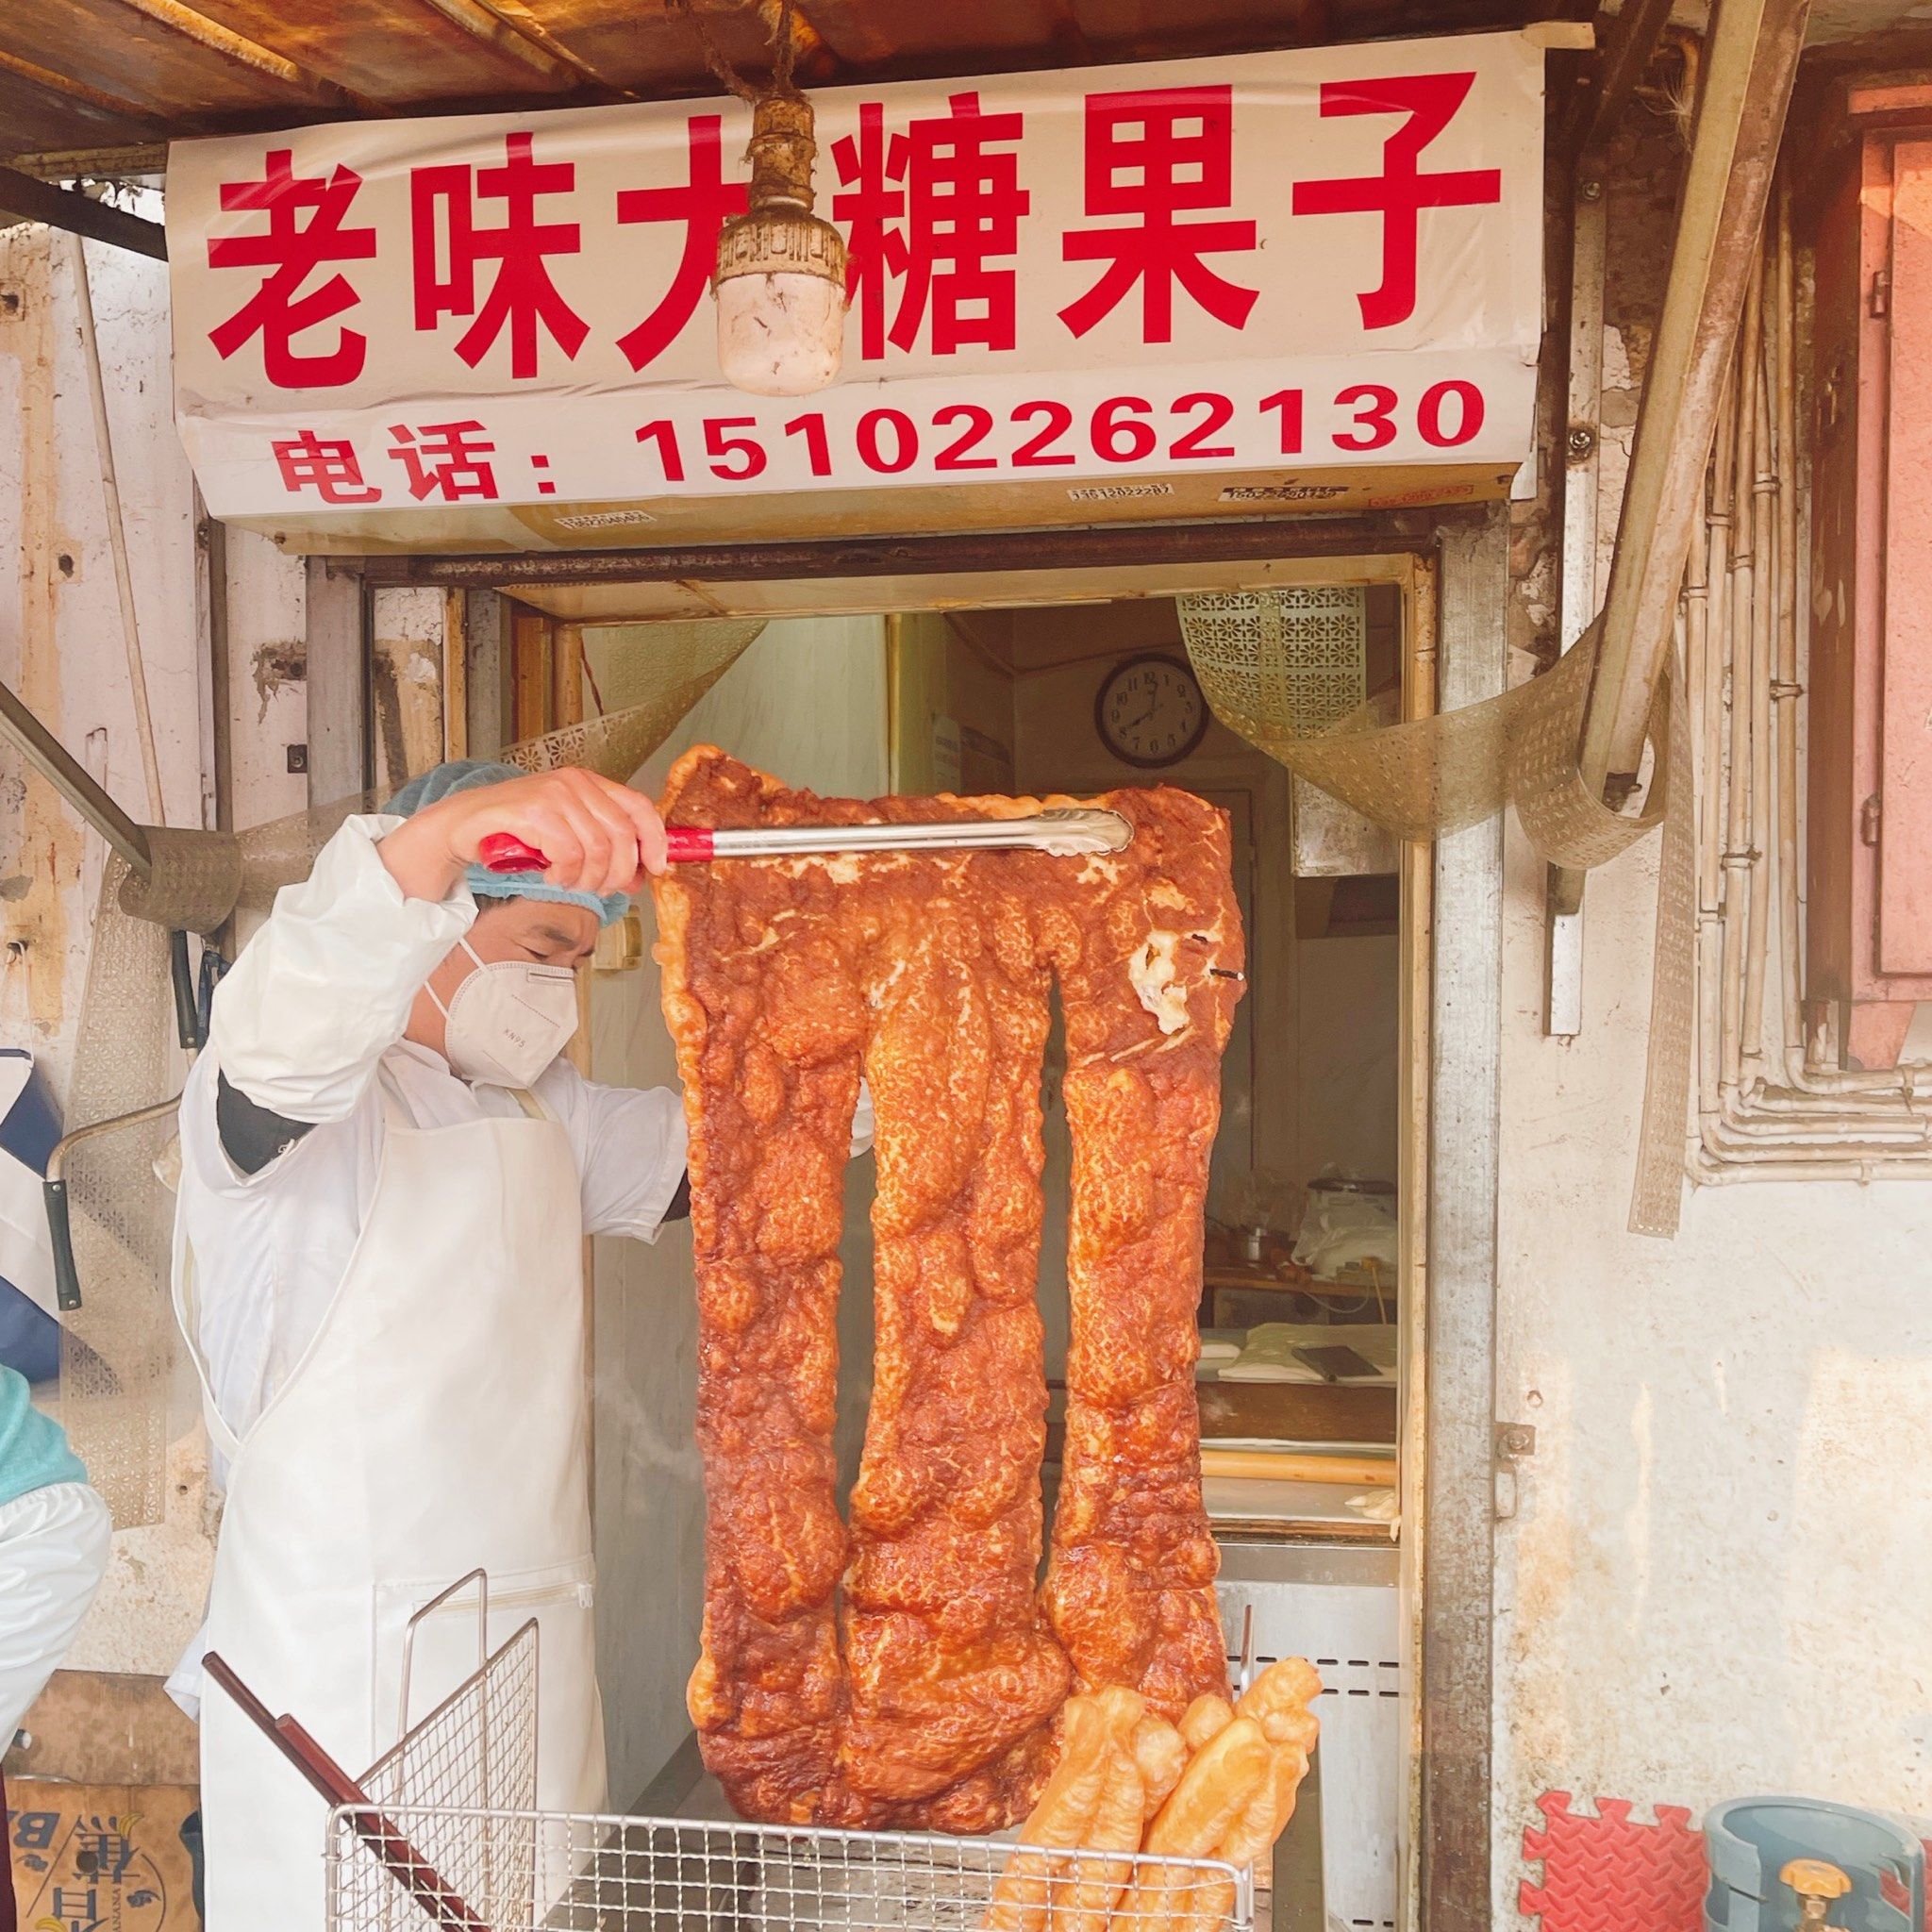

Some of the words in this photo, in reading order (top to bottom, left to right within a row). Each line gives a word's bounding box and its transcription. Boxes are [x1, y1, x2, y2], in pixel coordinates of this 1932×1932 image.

[208, 71, 1502, 389] 老味大糖果子
[635, 380, 1485, 481] 15102262130
